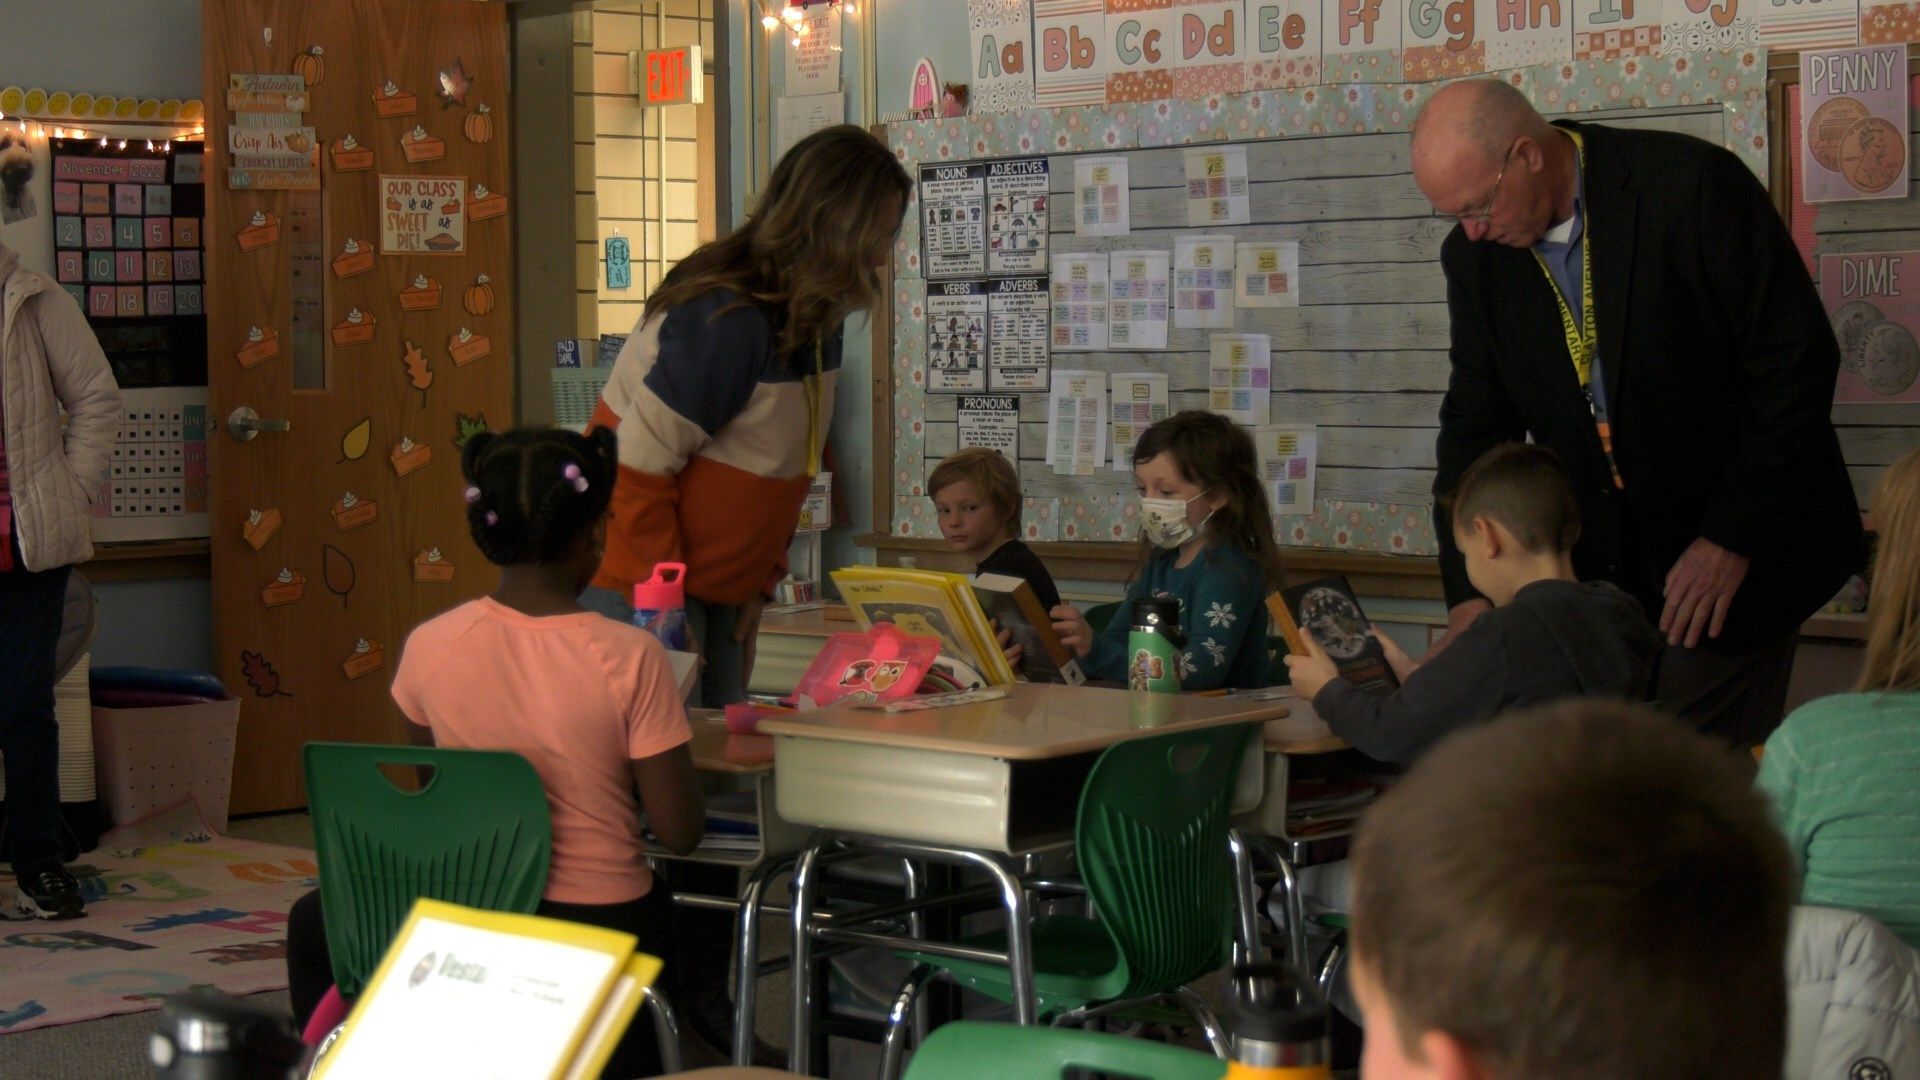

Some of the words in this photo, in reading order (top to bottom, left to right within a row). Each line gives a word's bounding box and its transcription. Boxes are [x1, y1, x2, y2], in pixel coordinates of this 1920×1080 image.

[978, 34, 1024, 78] Aa
[1043, 25, 1096, 72] Bb
[1115, 19, 1161, 65] Cc
[1181, 9, 1234, 59] Dd
[1258, 5, 1306, 52] Ee
[1338, 0, 1379, 46] Ff
[1409, 0, 1475, 51] Gg
[647, 51, 686, 101] EXIT
[1809, 50, 1897, 95] PENNY
[245, 75, 300, 91] Autumn
[234, 132, 260, 154] Crisp
[62, 162, 125, 175] November
[132, 164, 164, 178] 2022
[936, 166, 968, 180] NOUNS
[990, 162, 1044, 176] ADJECTIVES
[388, 182, 412, 196] OUR
[418, 181, 458, 197] CLASS
[408, 198, 416, 210] is
[420, 198, 434, 210] as
[387, 212, 428, 232] SWEET
[438, 216, 452, 229] as
[64, 223, 74, 242] 2
[94, 224, 104, 242] 3
[123, 225, 134, 243] 4
[152, 224, 163, 242] 5
[180, 225, 192, 242] 6
[65, 258, 76, 276] 9
[94, 258, 110, 276] 10
[125, 256, 134, 274] 11
[152, 258, 167, 276] 12
[179, 256, 194, 276] 13
[999, 280, 1038, 292] ADVERBS
[1842, 256, 1902, 298] DIME
[944, 283, 970, 294] VERBS
[96, 292, 109, 311] 17
[122, 293, 138, 310] 18
[152, 290, 169, 308] 19
[177, 290, 200, 309] 20
[1580, 304, 1595, 364] CLAYTON
[558, 353, 574, 364] DAHL
[964, 398, 1012, 410] PRONOUNS
